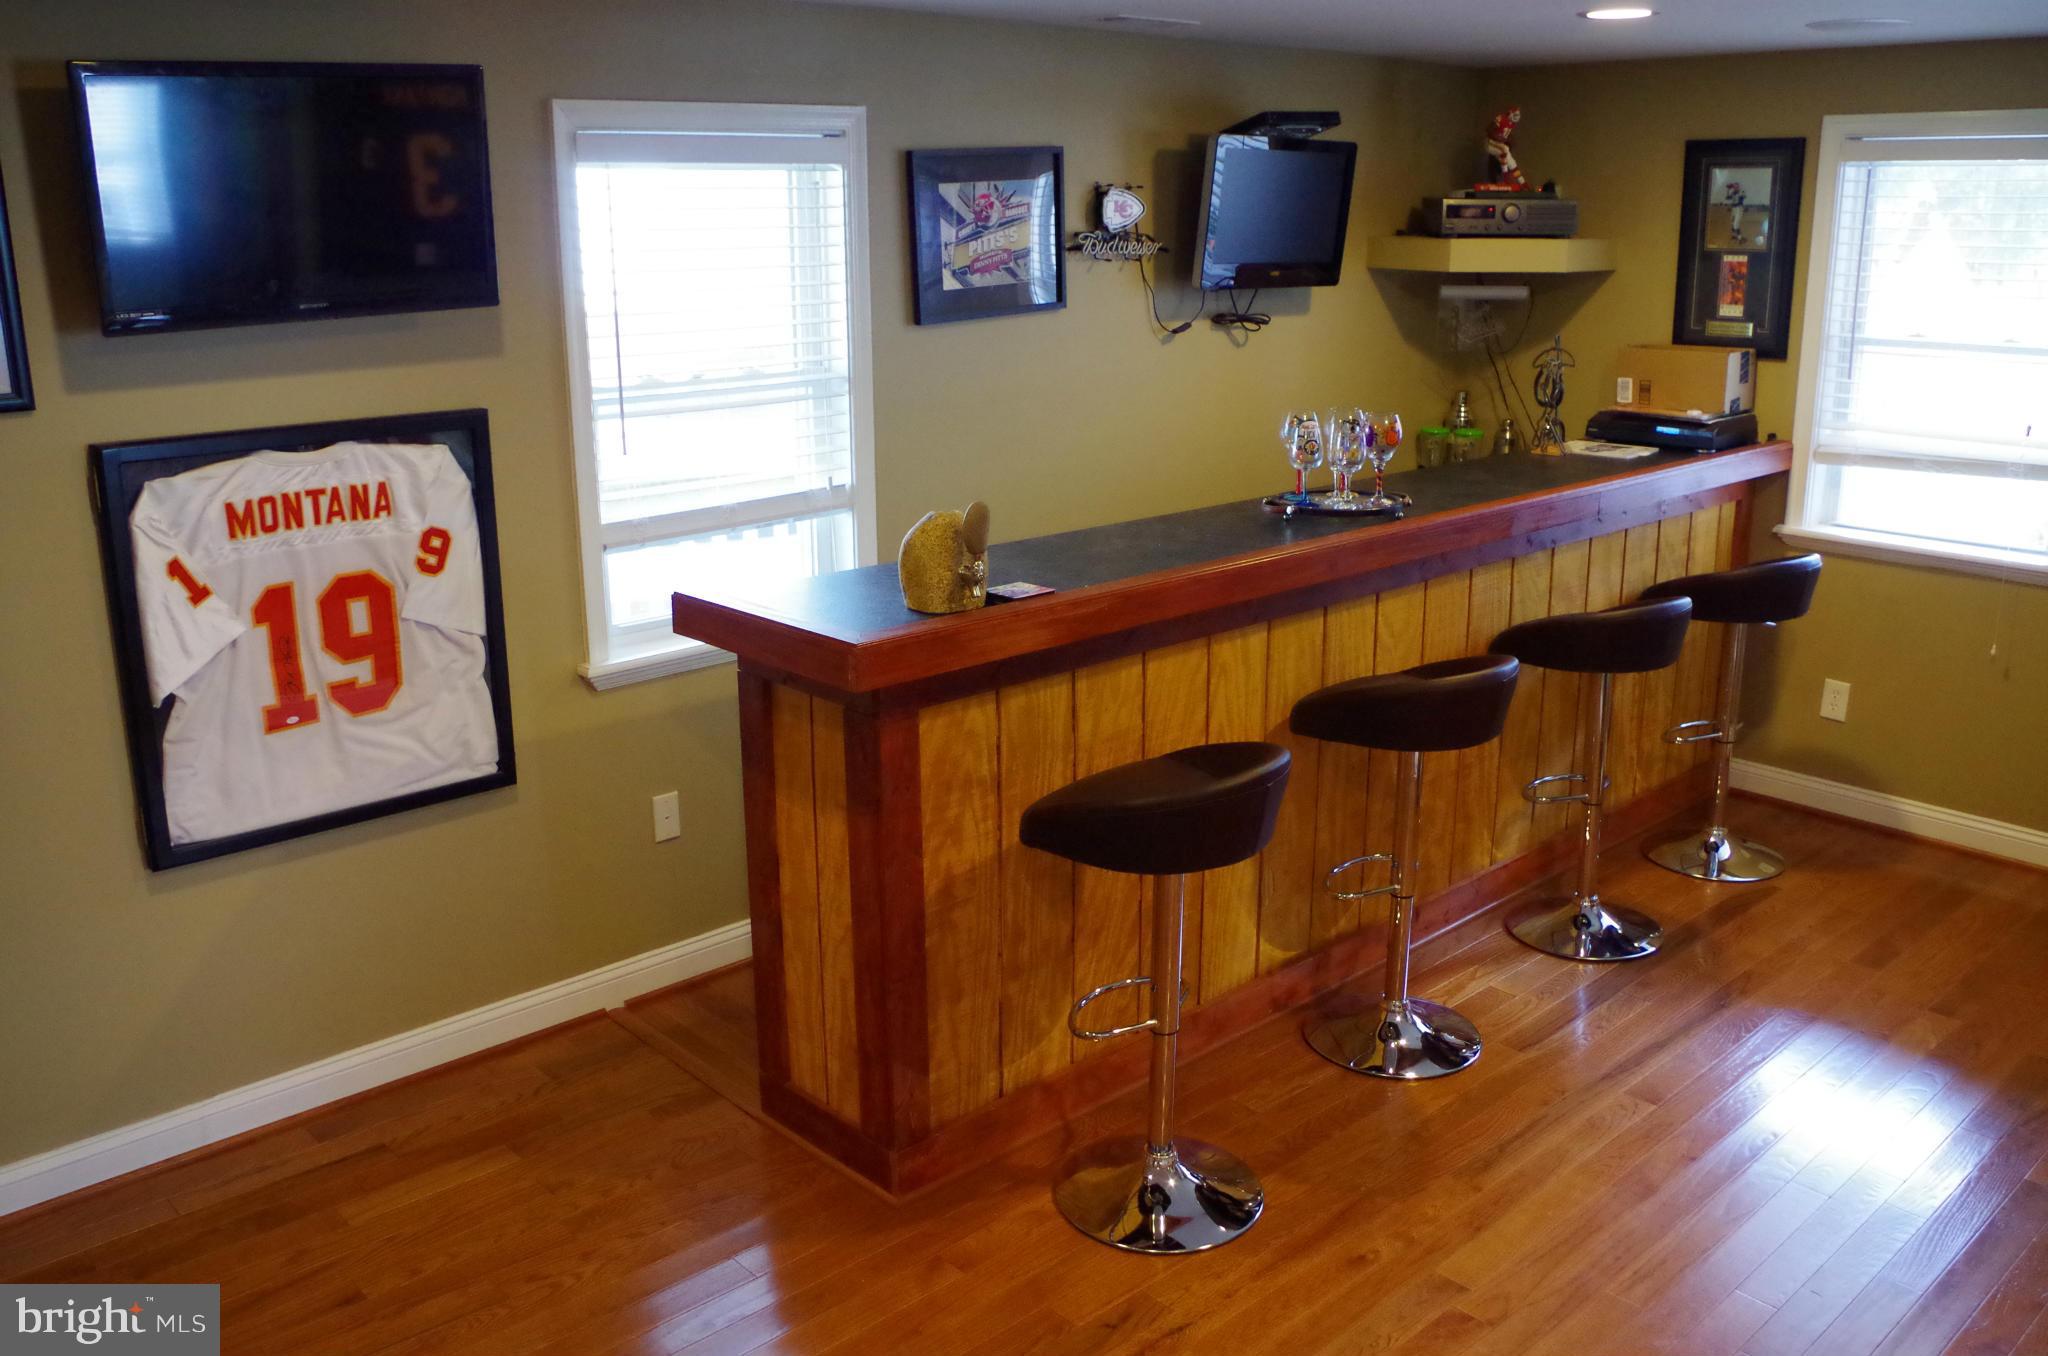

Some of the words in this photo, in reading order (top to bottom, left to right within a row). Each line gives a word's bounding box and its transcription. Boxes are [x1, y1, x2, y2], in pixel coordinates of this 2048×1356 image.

[1113, 199, 1133, 218] KC
[1079, 231, 1162, 255] Budweiser
[225, 480, 393, 541] MONTANA
[414, 526, 452, 576] 9
[165, 555, 213, 608] 1
[250, 569, 404, 735] 19
